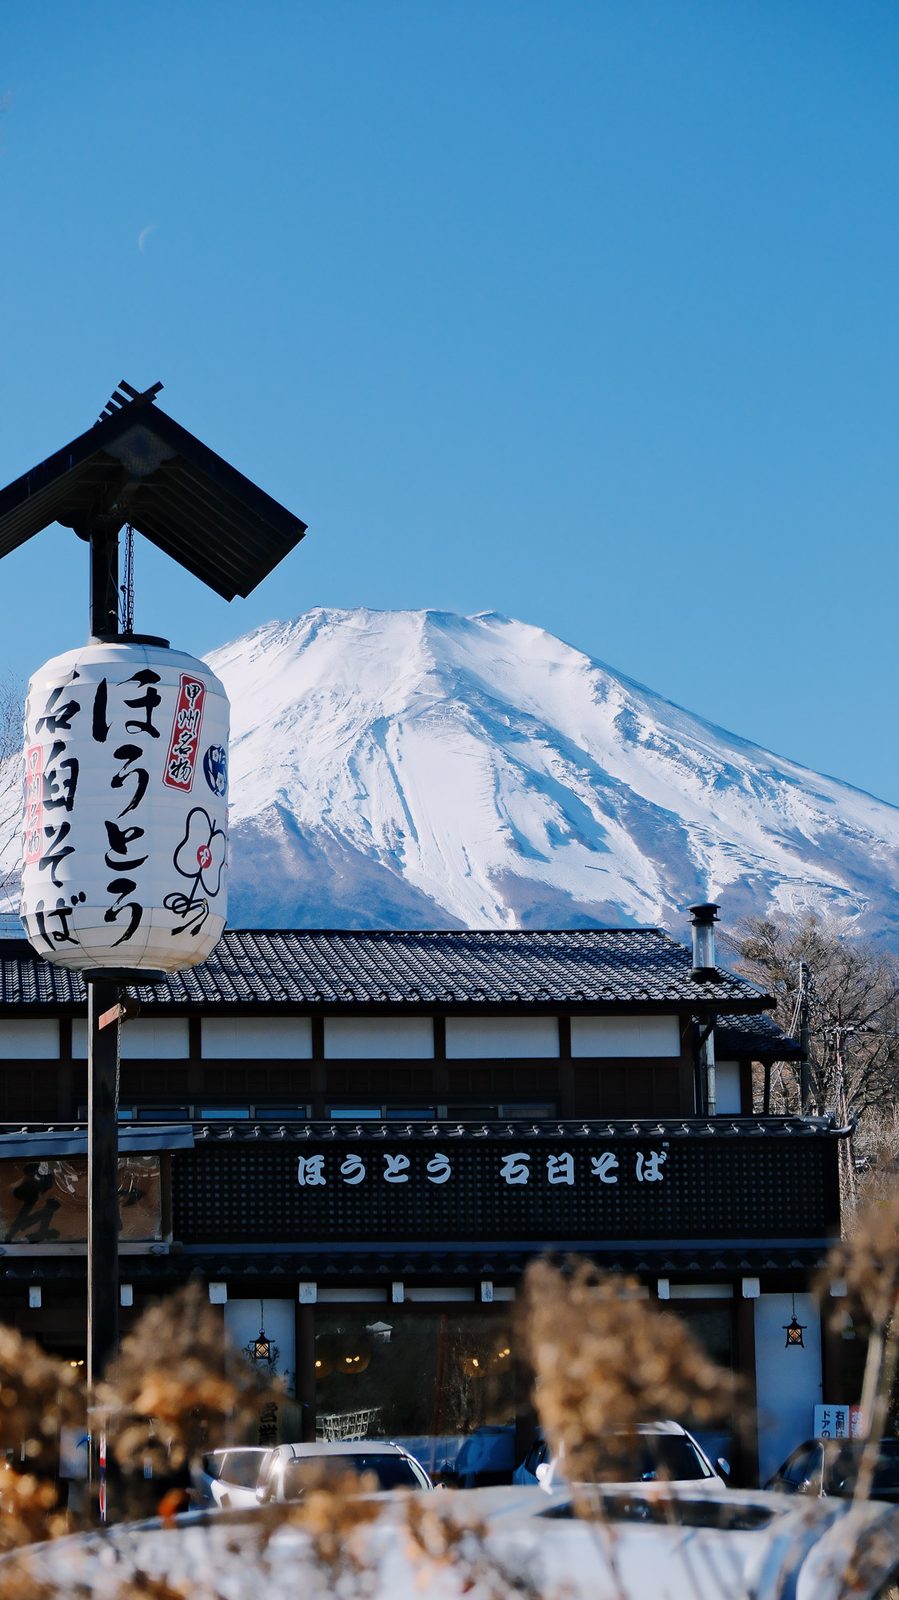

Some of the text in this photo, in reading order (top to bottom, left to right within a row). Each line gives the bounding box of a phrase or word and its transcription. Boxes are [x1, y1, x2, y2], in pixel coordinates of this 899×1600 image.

[167, 681, 202, 785] 甲州名物
[92, 669, 162, 947] ほうとう
[298, 1151, 667, 1185] ほうとう 石臼そば
